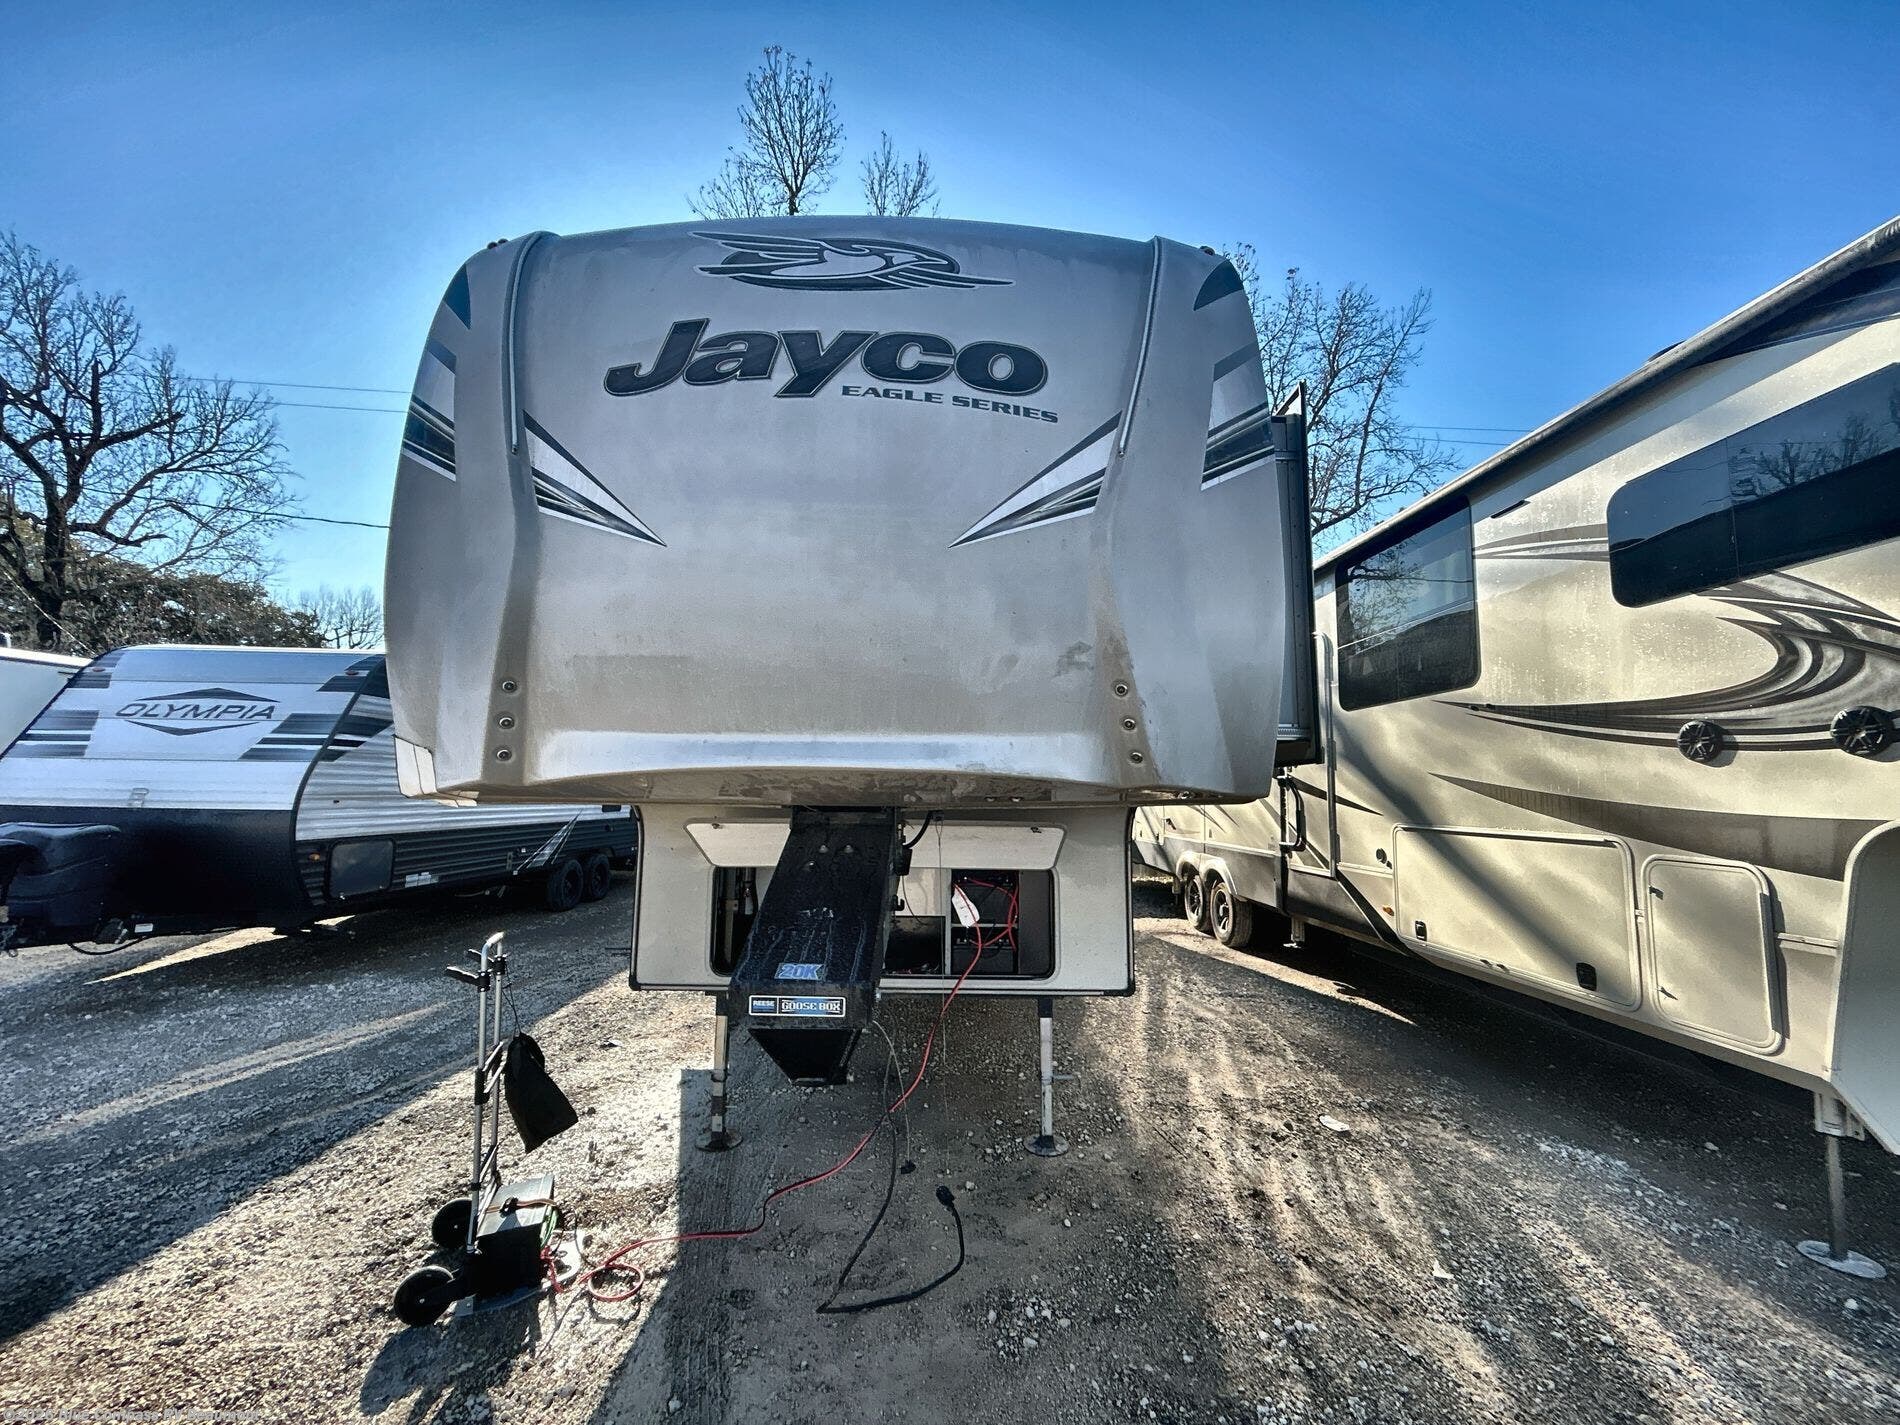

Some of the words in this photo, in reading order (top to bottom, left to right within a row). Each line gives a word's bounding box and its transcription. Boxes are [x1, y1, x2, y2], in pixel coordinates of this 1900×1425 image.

[603, 317, 1049, 398] Jayco
[841, 385, 944, 403] EAGLE
[951, 395, 1059, 423] SERIES
[115, 703, 276, 720] OLYMPIA
[779, 964, 820, 979] 20K
[781, 1001, 817, 1012] GOOSE
[819, 1001, 841, 1012] BOX
